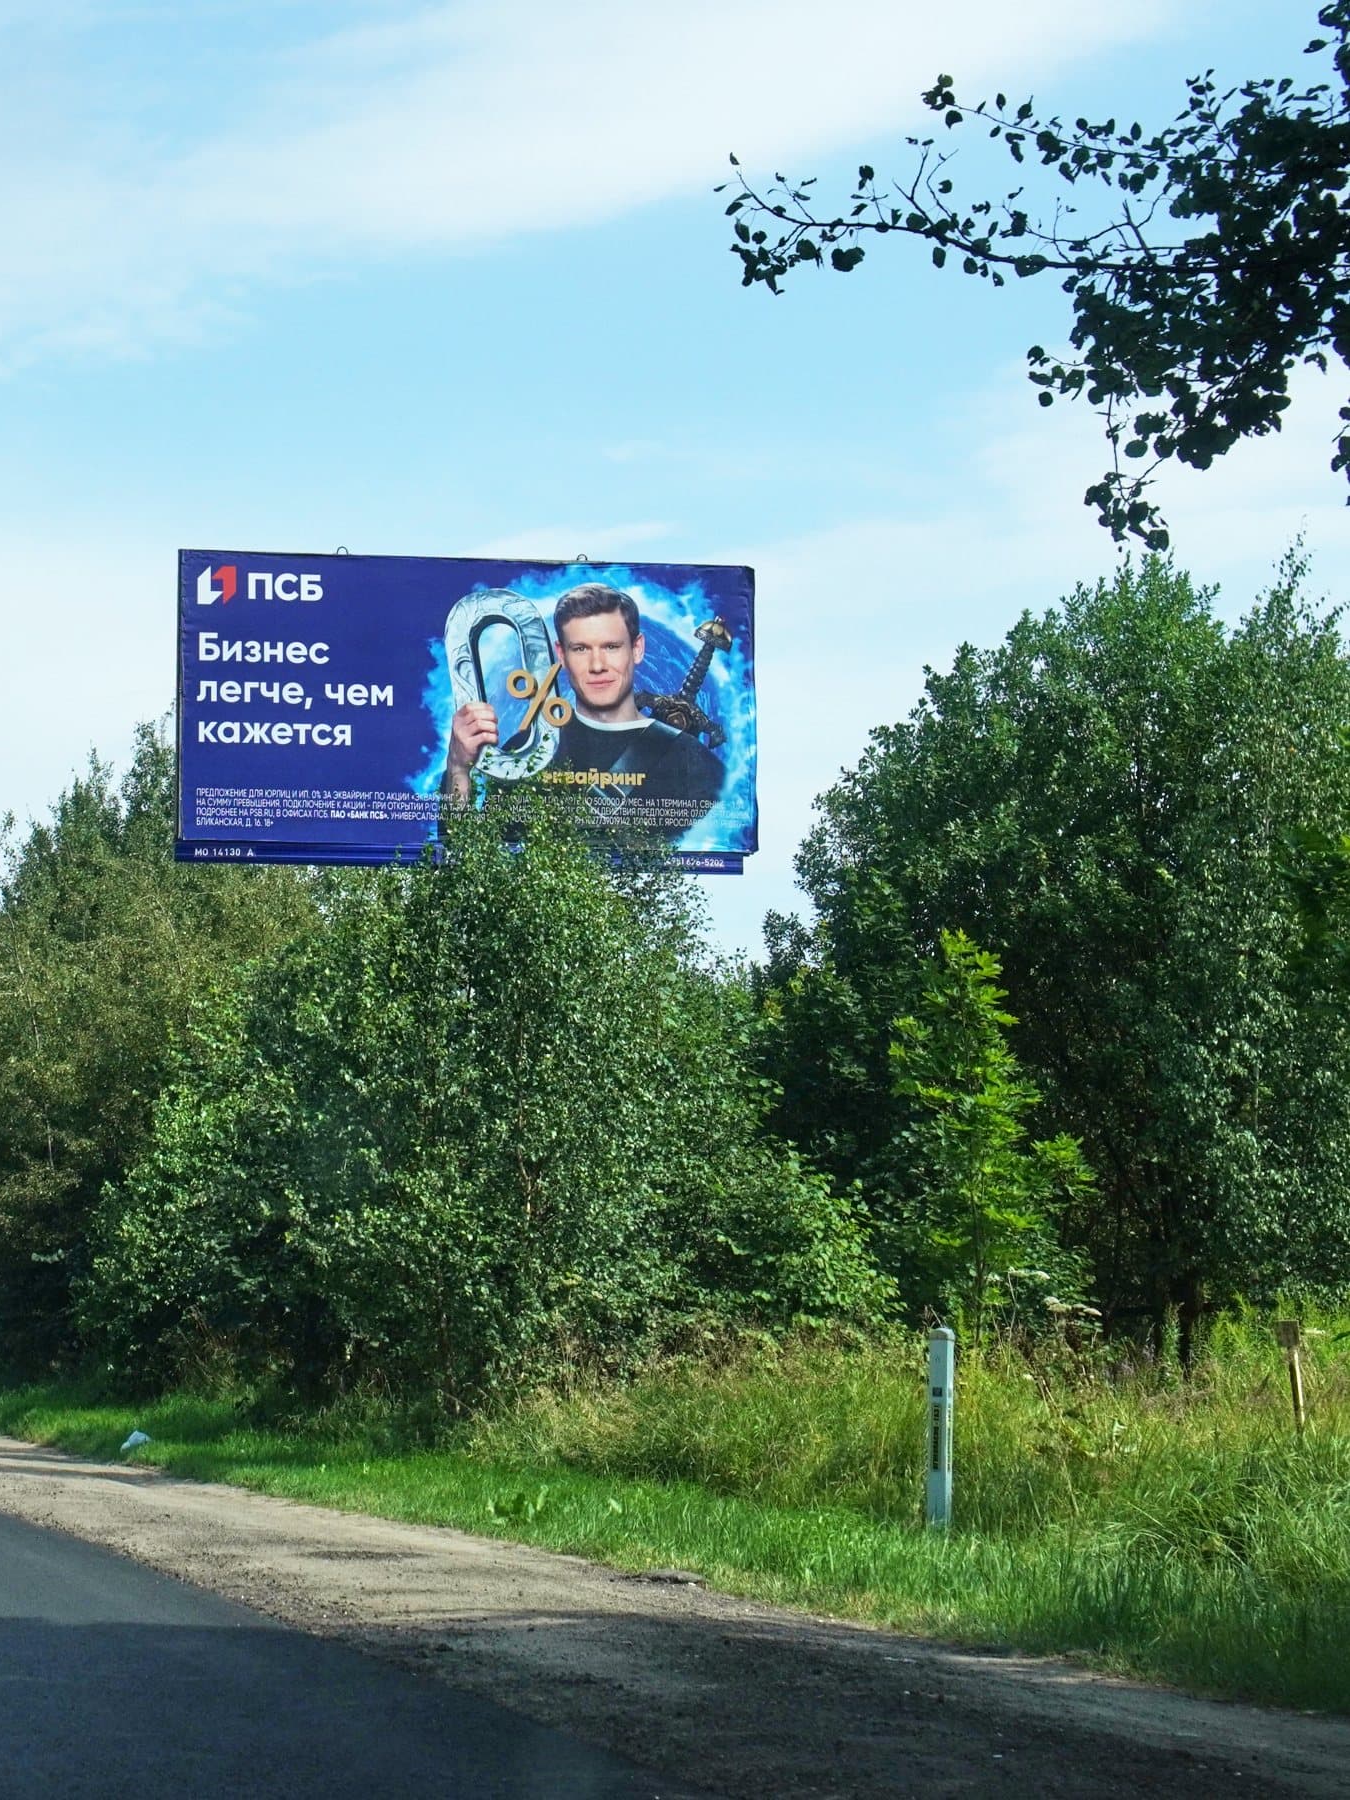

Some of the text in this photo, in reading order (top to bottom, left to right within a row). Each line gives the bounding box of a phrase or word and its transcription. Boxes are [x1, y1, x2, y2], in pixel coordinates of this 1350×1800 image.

[248, 572, 323, 601] ПСБ
[198, 632, 330, 664] Бизнес
[196, 680, 394, 710] легче, чем
[198, 720, 351, 746] кажется
[196, 788, 247, 797] ПРЕДЛОЖЕНИЕ
[249, 788, 264, 798] ДЛЯ
[265, 789, 290, 799] ЮРЛИЦ
[292, 790, 298, 798] И
[322, 790, 332, 799] ЗА
[332, 790, 373, 800] ЭКВАЙРИНГ
[374, 791, 385, 800] ПО
[386, 791, 410, 801] АКЦИИ
[196, 798, 206, 806] НА
[207, 798, 231, 807] СУММУ
[282, 800, 335, 809] ПОДКЛЮЧЕНИЕ
[336, 801, 342, 809] К
[342, 801, 366, 810] АКЦИИ
[372, 801, 386, 810] ПРИ
[387, 802, 423, 811] ОТКРЫТИИ
[645, 798, 655, 807] НА
[196, 808, 237, 816] ПОДРОБНЕЕ
[238, 808, 248, 816] НА
[275, 809, 281, 817] В
[282, 809, 312, 818] ОФИСАХ
[330, 811, 346, 819] ПАО
[347, 811, 369, 819] «БАНК
[390, 812, 448, 821] УНИВЕРСАЛЬНА
[196, 817, 244, 827] БЛИКАНСКАЯ,
[194, 848, 208, 856] МО
[213, 848, 241, 856] 14130
